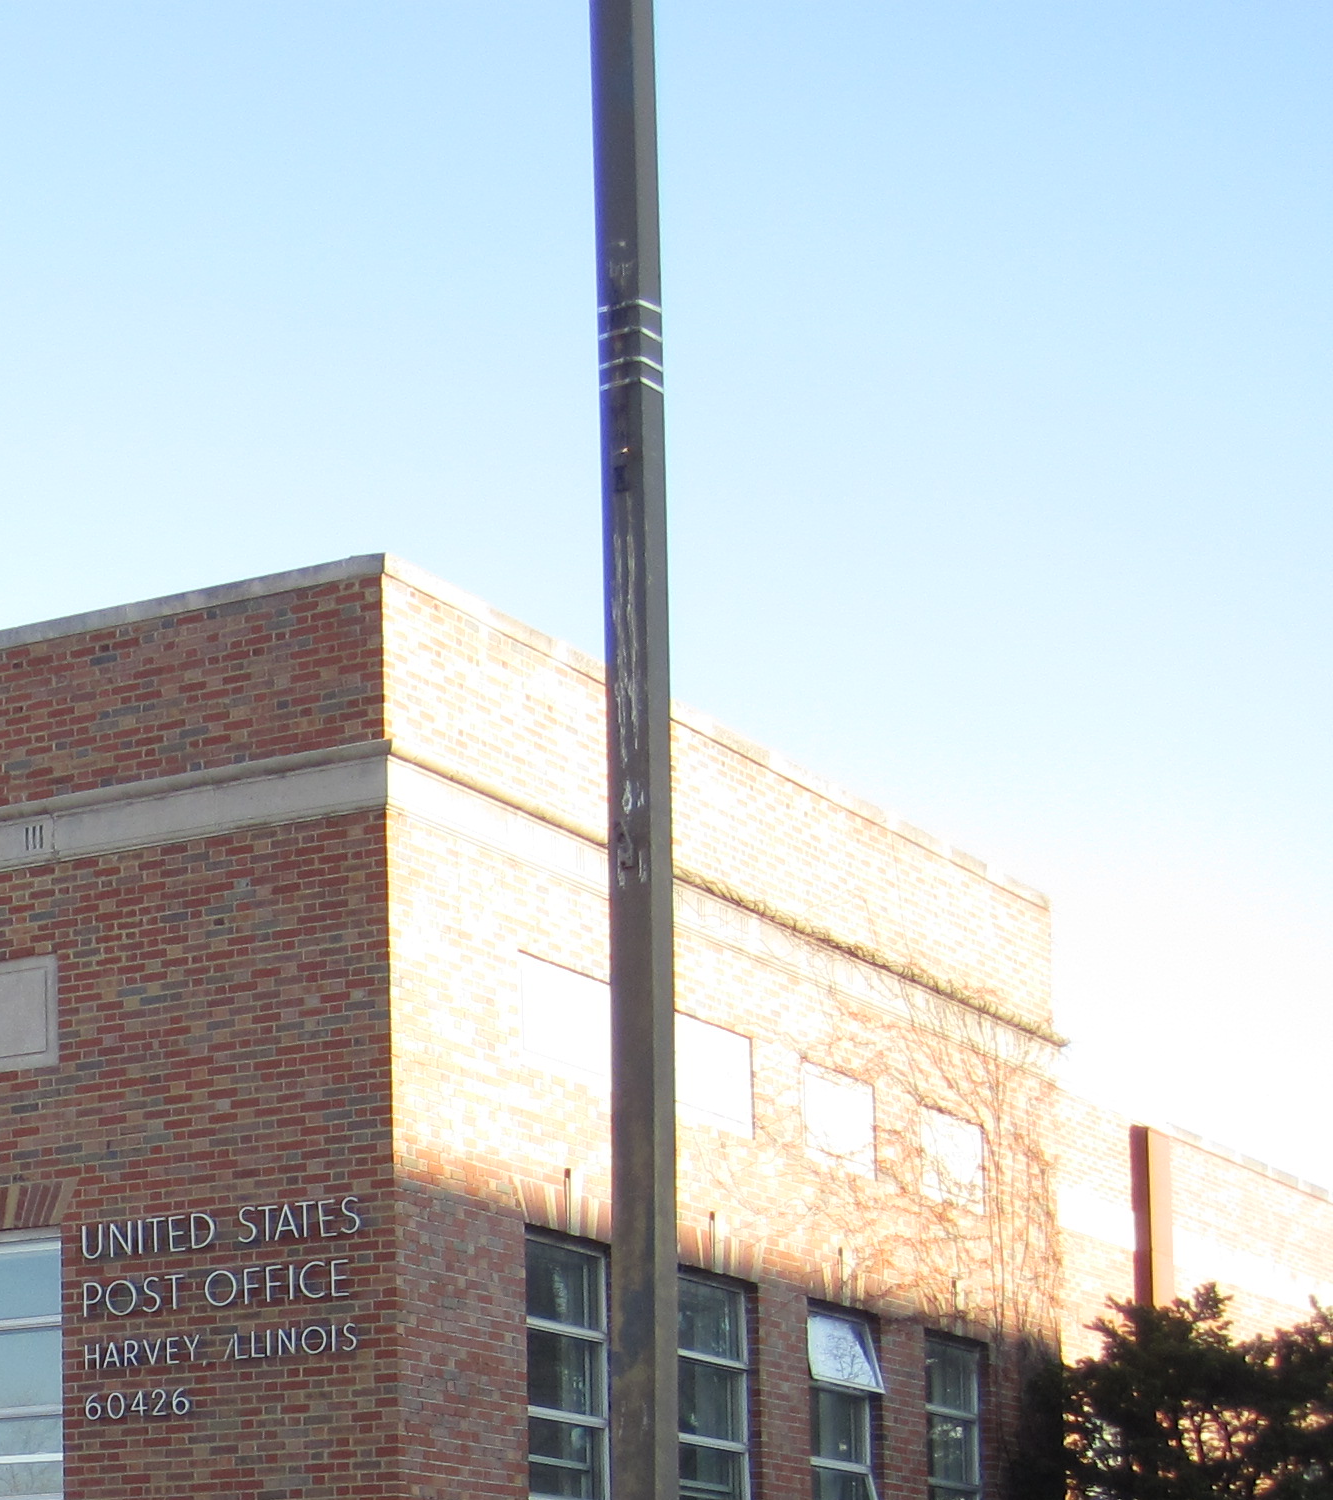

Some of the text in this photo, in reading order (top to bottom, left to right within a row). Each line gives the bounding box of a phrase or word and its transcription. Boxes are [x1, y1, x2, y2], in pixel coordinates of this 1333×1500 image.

[81, 1196, 361, 1260] UNITED STATES
[83, 1259, 350, 1317] POST OFFICE
[84, 1323, 358, 1370] HARVEY, ILLINOIS
[85, 1388, 191, 1421] 60426
